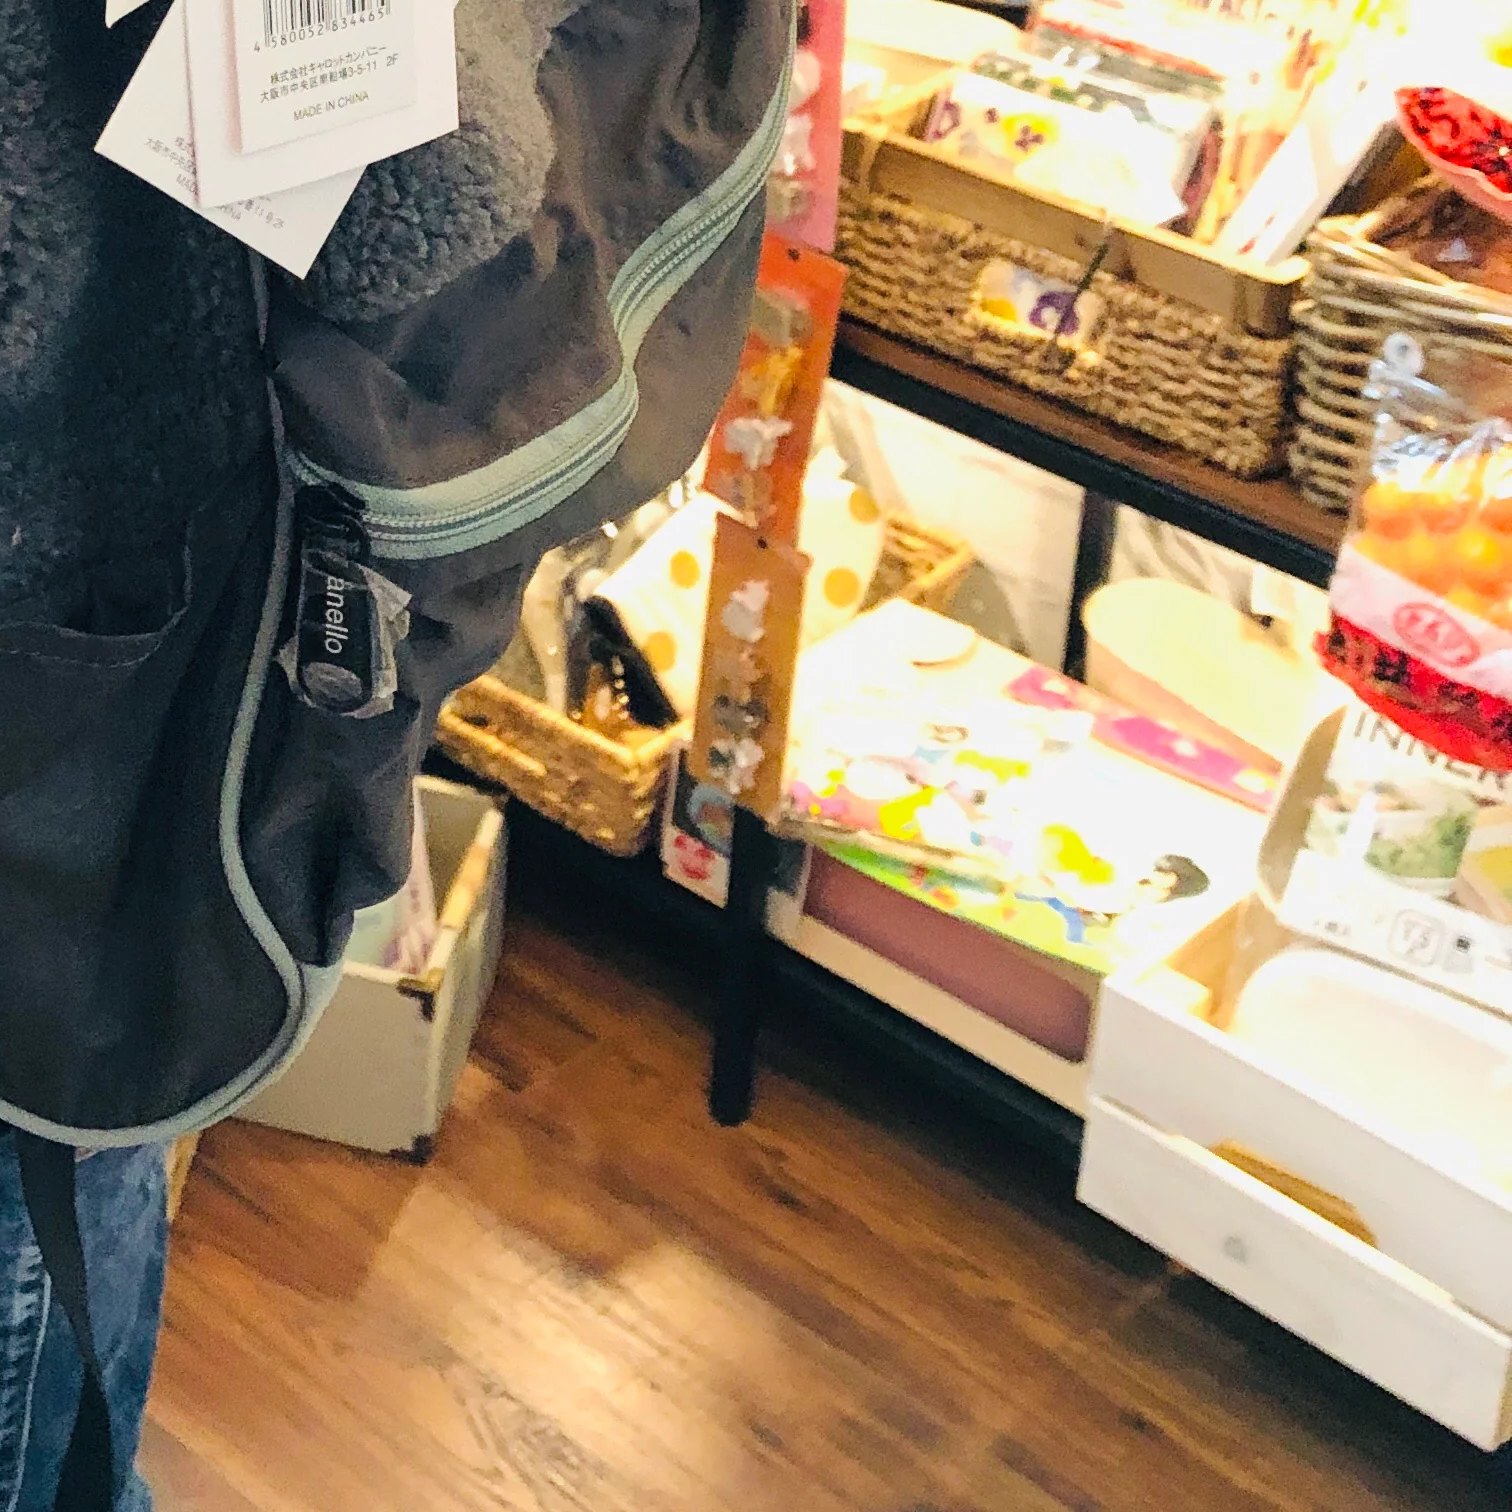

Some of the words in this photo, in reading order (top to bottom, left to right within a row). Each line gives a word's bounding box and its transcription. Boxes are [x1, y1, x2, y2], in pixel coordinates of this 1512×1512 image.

[293, 103, 323, 122] MADE
[325, 98, 336, 112] IN
[337, 90, 369, 109] CHINA
[324, 575, 349, 654] anello
